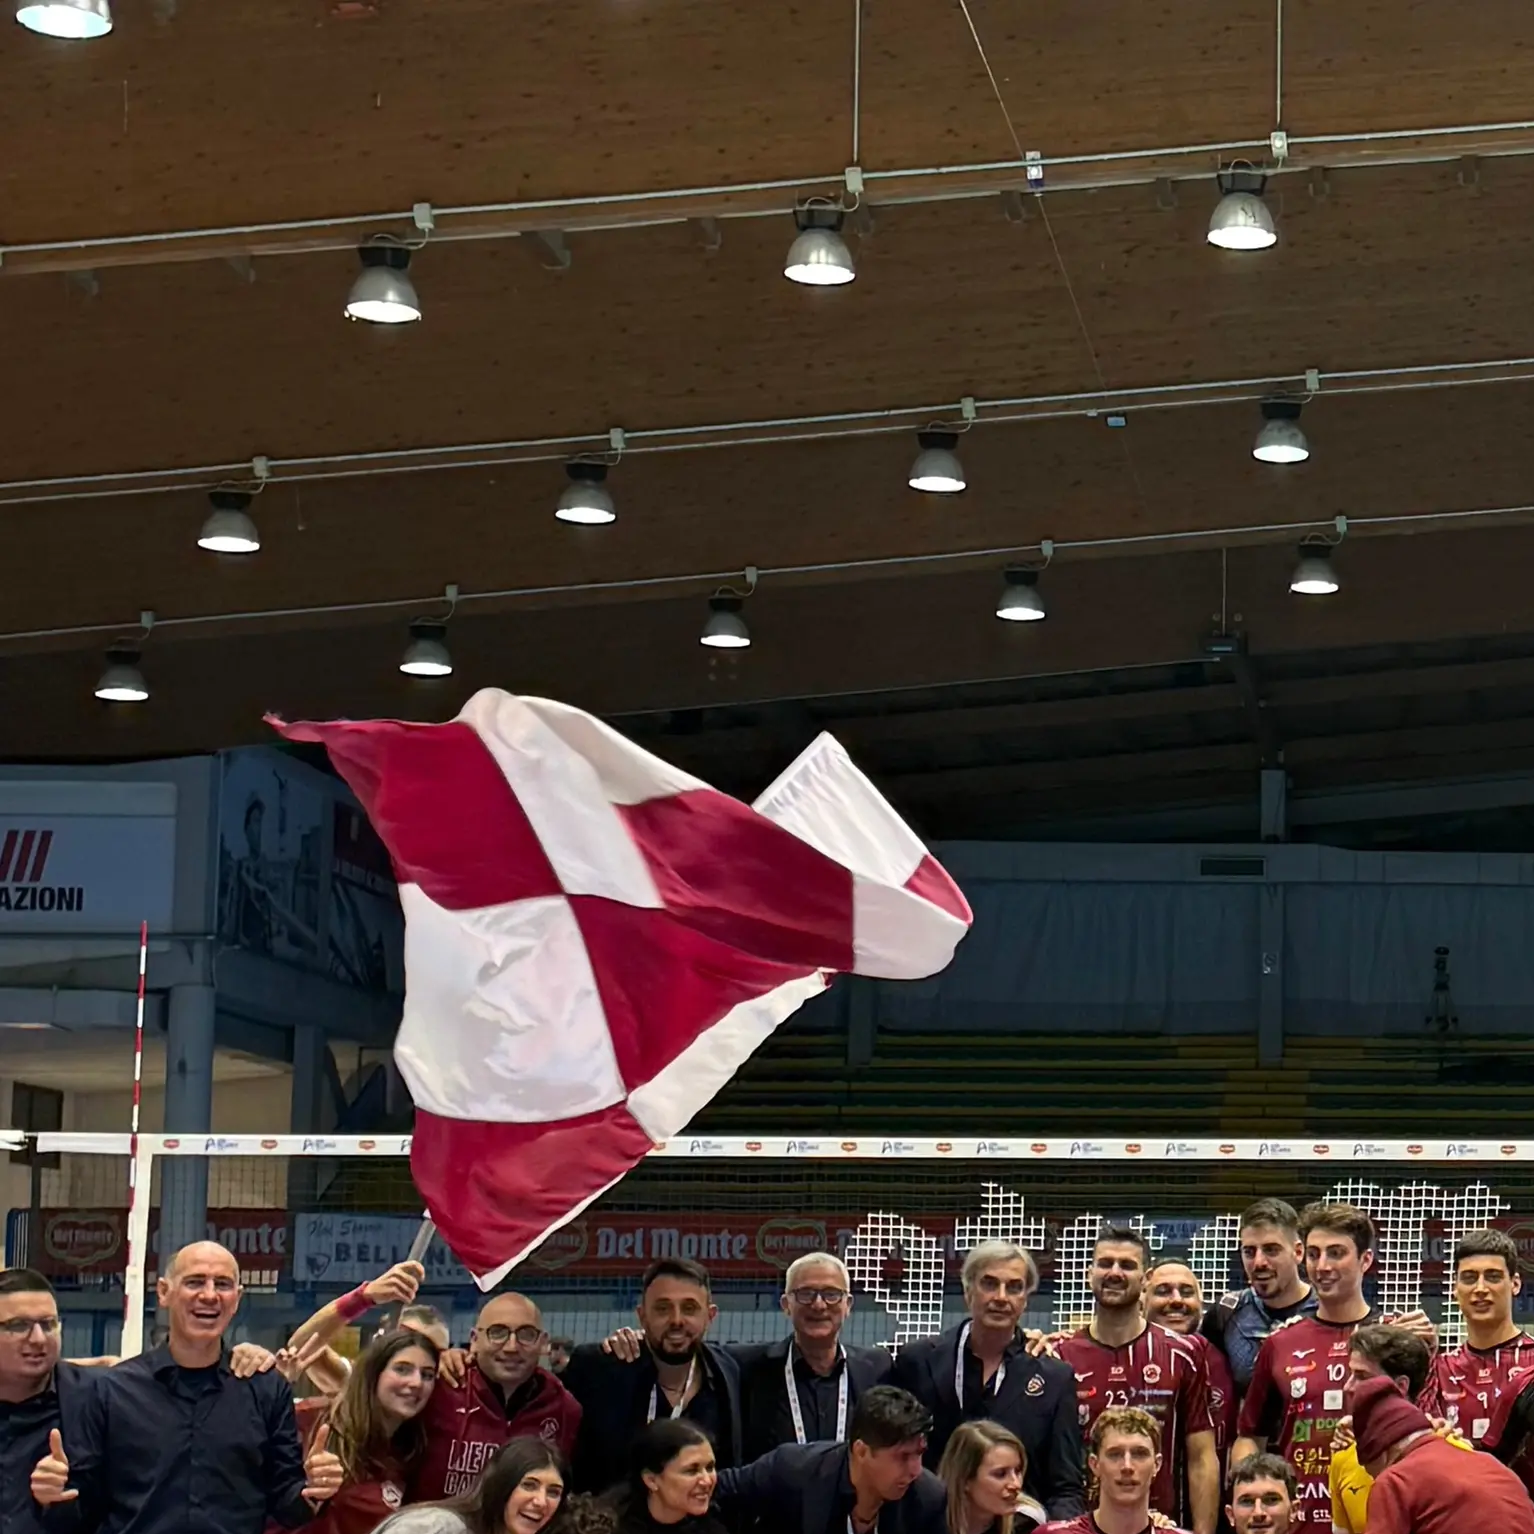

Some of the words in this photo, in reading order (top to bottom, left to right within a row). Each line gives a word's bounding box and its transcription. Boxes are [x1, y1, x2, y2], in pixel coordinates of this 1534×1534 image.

[206, 1222, 287, 1255] onte
[595, 1228, 644, 1260] Del
[650, 1228, 748, 1260] Monte
[1326, 1363, 1345, 1382] 10
[1105, 1389, 1129, 1409] 23
[1476, 1391, 1488, 1409] 9
